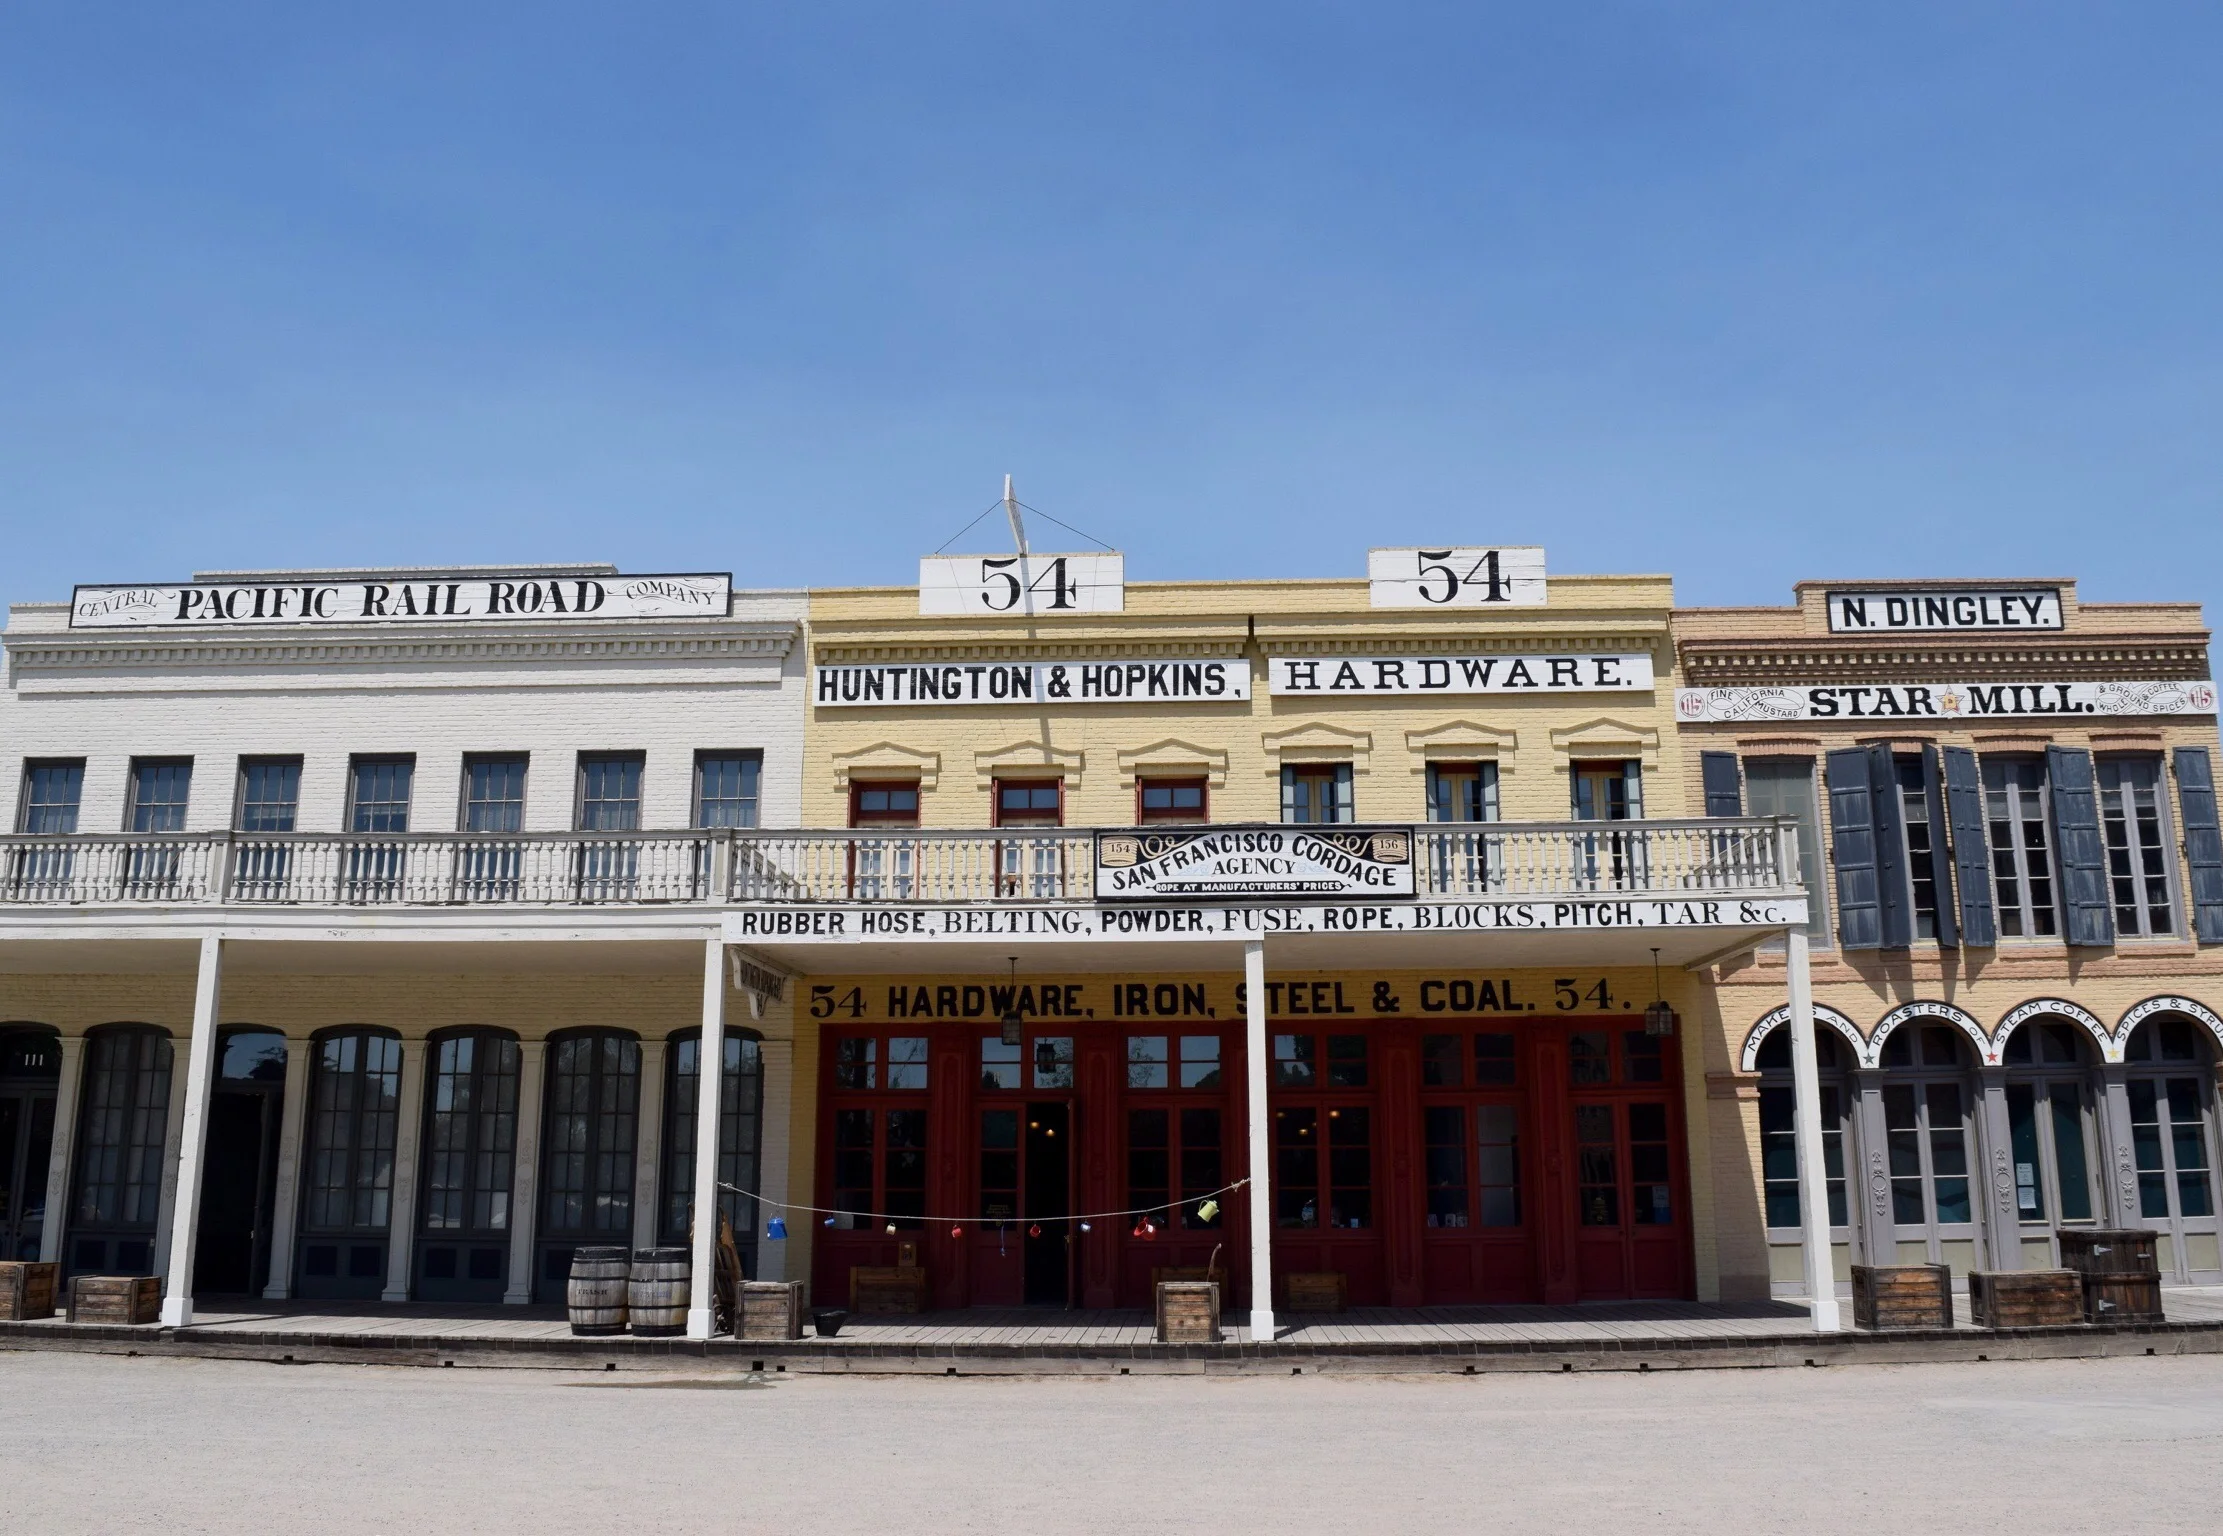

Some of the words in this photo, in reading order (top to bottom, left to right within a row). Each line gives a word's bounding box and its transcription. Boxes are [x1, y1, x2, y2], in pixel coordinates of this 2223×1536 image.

[981, 557, 1076, 610] 54
[1418, 550, 1511, 603] 54
[79, 589, 159, 617] CENTRAL
[174, 587, 339, 620] PACIFIC
[359, 584, 472, 617] RAIL
[484, 580, 606, 615] ROAD
[626, 580, 717, 606] COMPANY
[1842, 597, 1876, 627] N.
[1886, 596, 2050, 626] DINGLEY.
[819, 666, 1032, 701] HUNTINGTON
[1047, 665, 1071, 698] &
[1082, 663, 1241, 698] HOPKINS,
[1284, 658, 1632, 690] HARDWARE.
[1710, 689, 1733, 701] FINE
[1755, 701, 1798, 718] MUSTARD
[1723, 689, 1785, 719] CALIFORNIA
[1808, 687, 1938, 717] STAR
[1966, 684, 2095, 714] MILL.
[2099, 685, 2106, 693] &
[2108, 684, 2149, 709] GROUND
[2153, 697, 2186, 712] SPICES
[2099, 698, 2128, 713] WHOLE
[2148, 683, 2180, 696] COFFEE
[1111, 843, 1131, 853] 154
[1112, 863, 1156, 890] SAN
[1158, 832, 1284, 876] FRANCISCO
[1292, 835, 1397, 886] CORDAGE
[1380, 839, 1398, 850] 156
[1211, 857, 1296, 875] AGENCY
[1155, 883, 1179, 892] ROPE
[1182, 883, 1198, 892] AT
[1202, 882, 1300, 891] MANUFACTURERS'
[1303, 881, 1342, 891] PRICES
[742, 912, 845, 935] RUBBER
[861, 911, 936, 937] HOSE,
[942, 910, 1092, 936] BELTING,
[1102, 910, 1214, 935] POWDER,
[1222, 908, 1314, 932] FUSE,
[1323, 907, 1403, 931] ROPE,
[1411, 904, 1547, 928] BLOCKS,
[1555, 903, 1643, 927] PITCH,
[1652, 902, 1723, 924] TAR
[810, 985, 868, 1018] 54
[888, 983, 1094, 1019] HARDWARE,
[1114, 983, 1215, 1019] IRON,
[1372, 981, 1400, 1013] &
[1420, 979, 1535, 1012] COAL.
[1747, 1006, 1817, 1052] MAKES
[1826, 1015, 1858, 1043] AND
[1871, 1003, 1963, 1046] ROASTERS
[1968, 1027, 1986, 1046] OF
[1995, 1002, 2043, 1044] STEAM
[2050, 1002, 2108, 1043] COFFEE
[2117, 1000, 2161, 1042] SPICES
[2170, 998, 2181, 1009] &
[2188, 1003, 2223, 1040] SYRU
